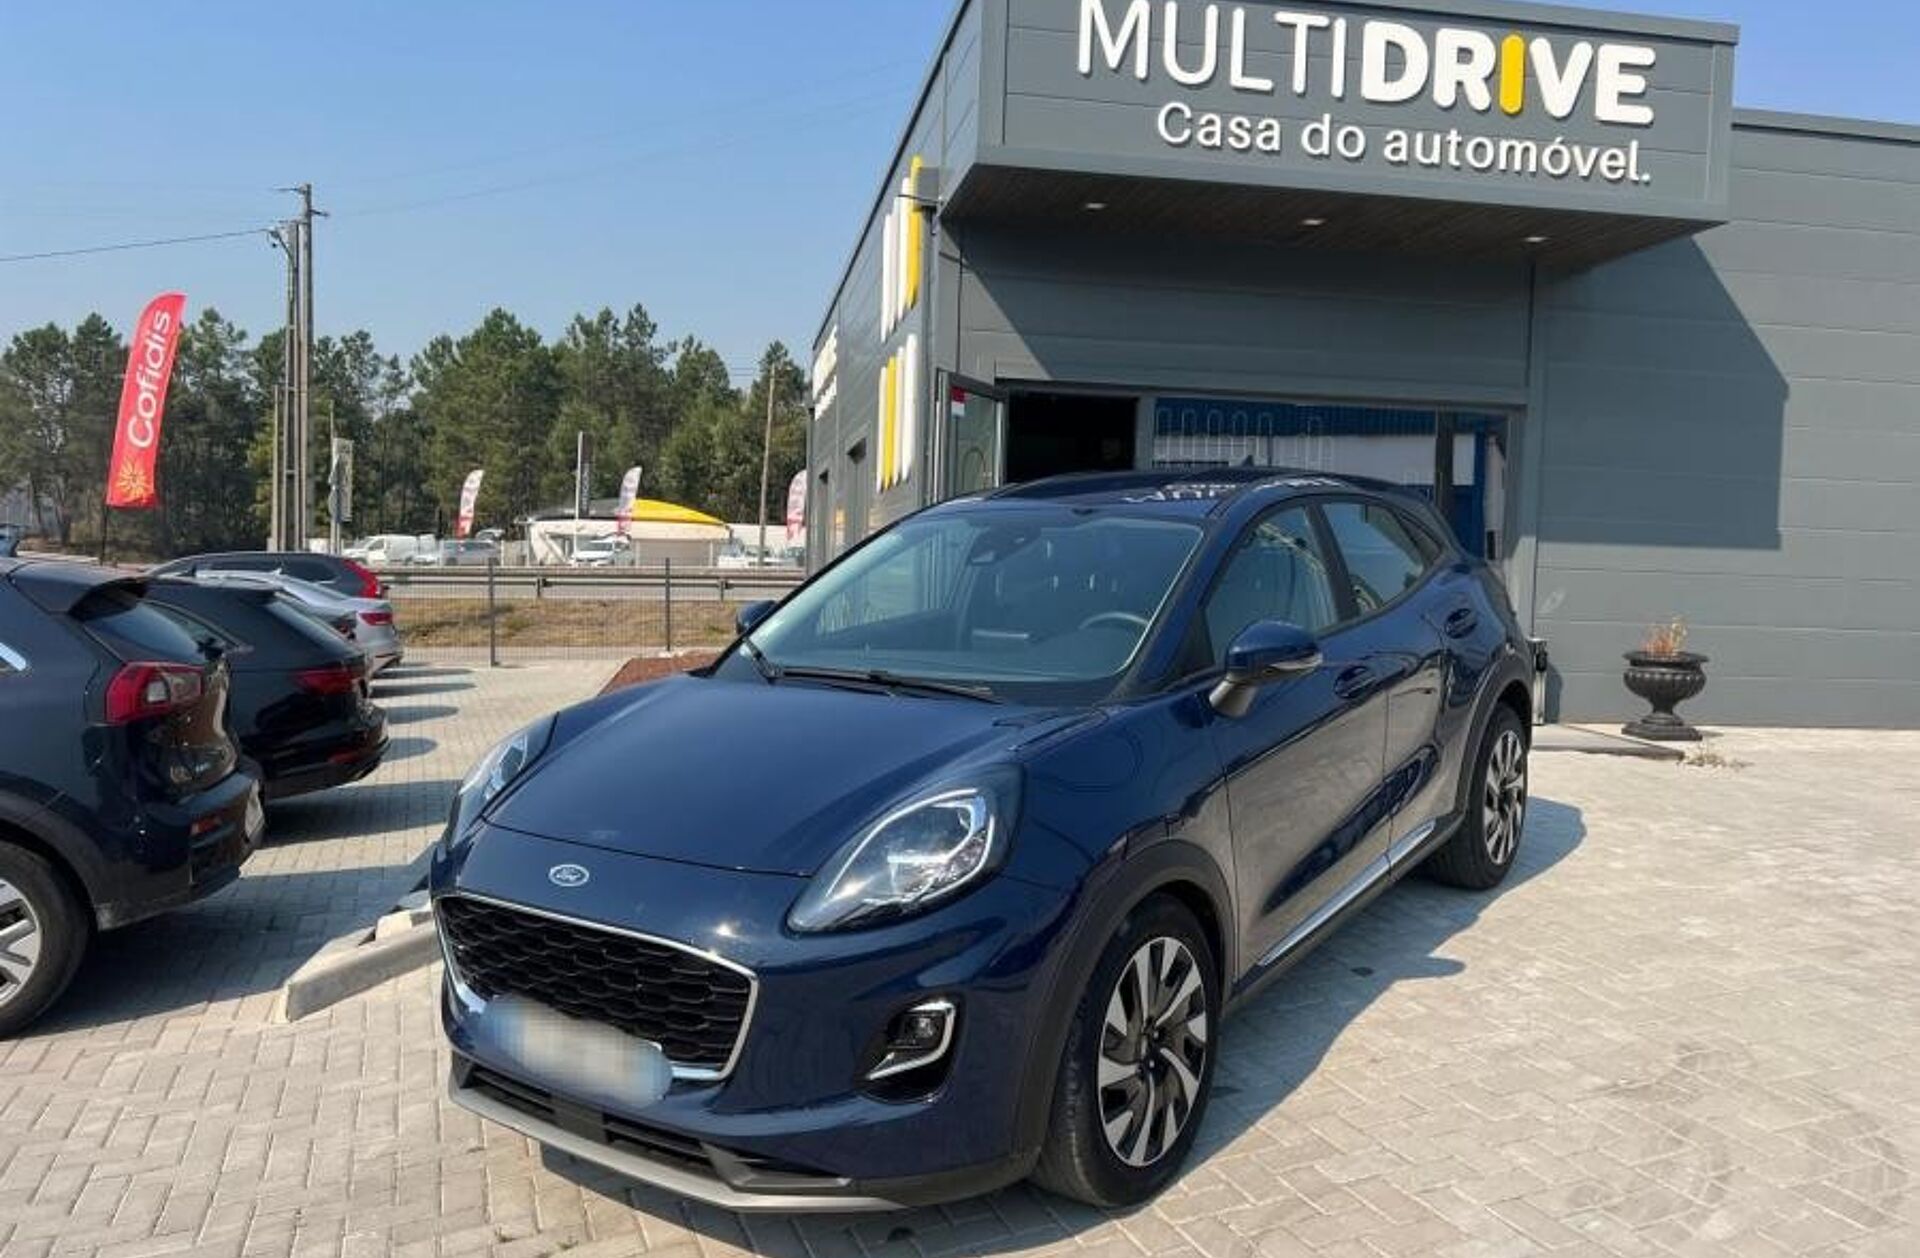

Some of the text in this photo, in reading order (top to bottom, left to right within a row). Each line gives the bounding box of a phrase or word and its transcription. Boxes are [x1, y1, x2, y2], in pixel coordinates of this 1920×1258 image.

[1078, 0, 1656, 125] MULTIDRIVE
[1157, 101, 1651, 182] Casa do automóvel.
[127, 310, 172, 449] Cofidis
